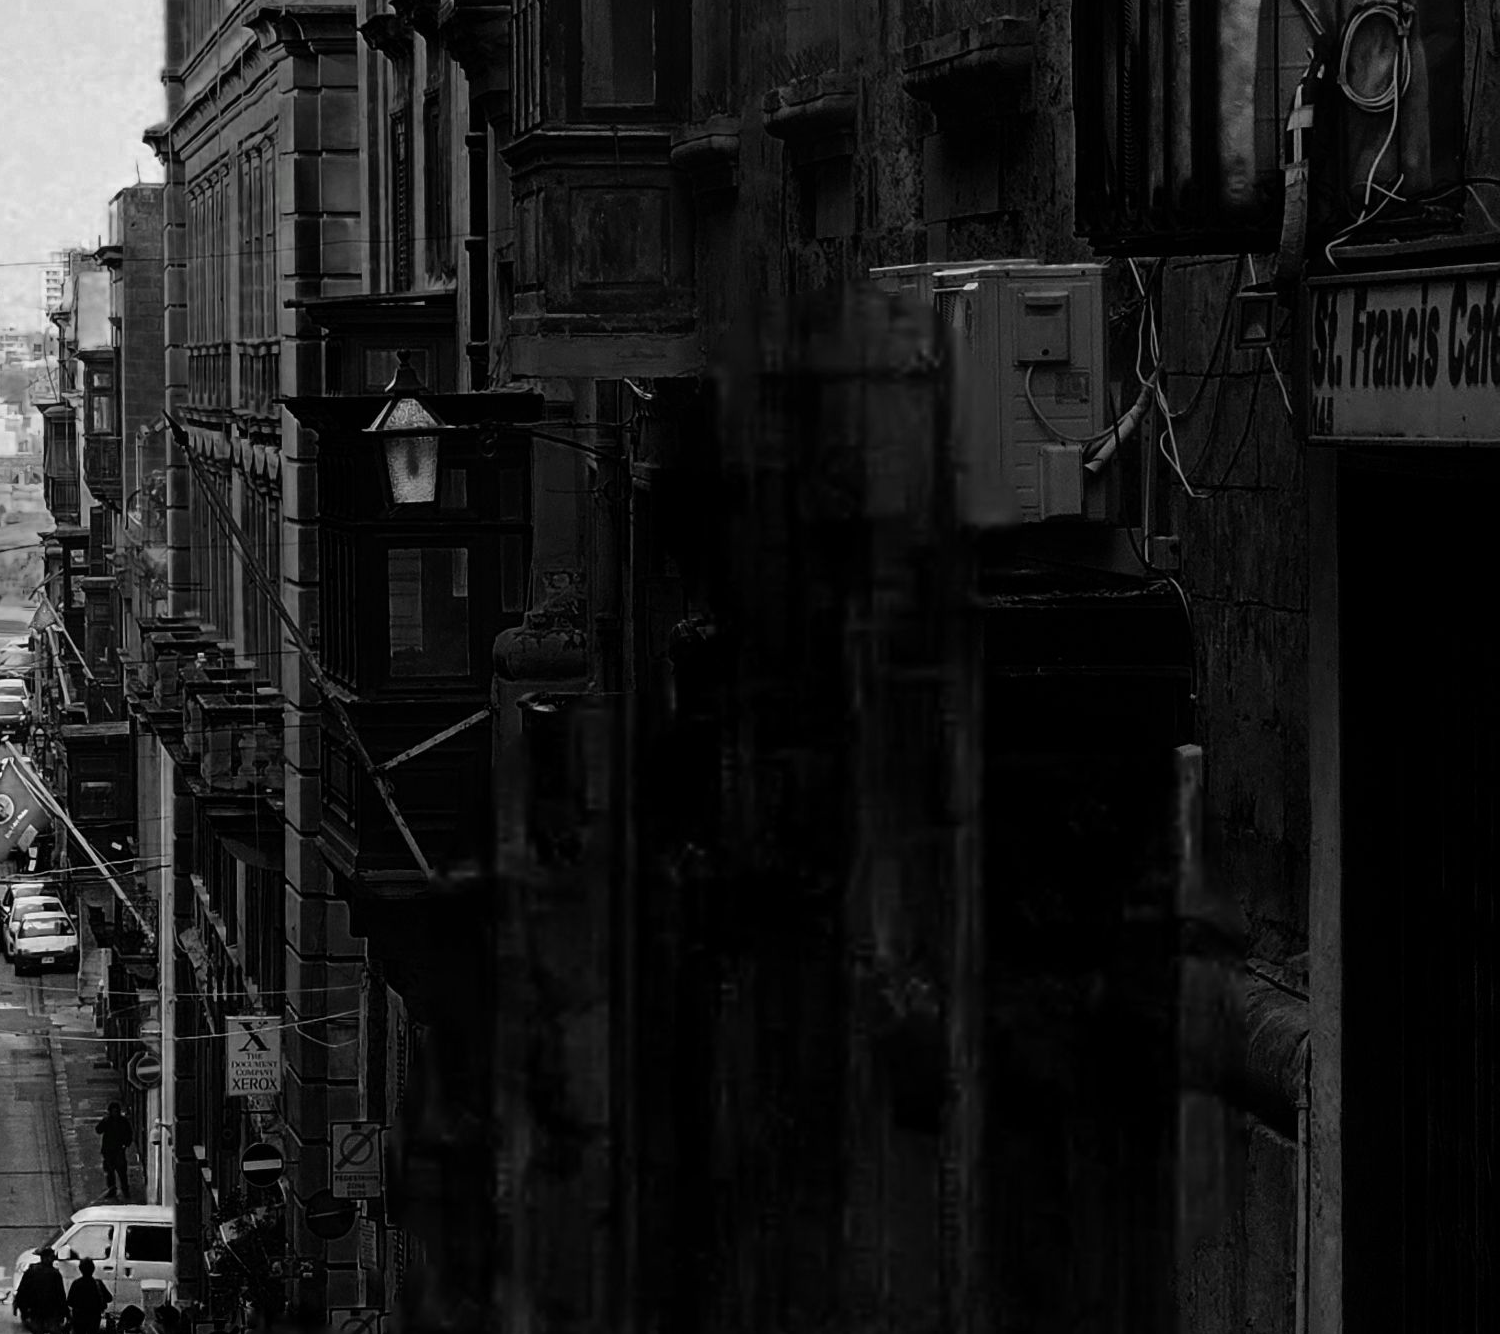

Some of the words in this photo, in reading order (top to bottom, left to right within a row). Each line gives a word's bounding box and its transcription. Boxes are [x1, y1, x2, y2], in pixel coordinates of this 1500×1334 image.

[1312, 286, 1342, 388] St.
[1350, 281, 1440, 388] Francis
[231, 1060, 277, 1068] DOCUMENT
[232, 1077, 277, 1090] XEROX
